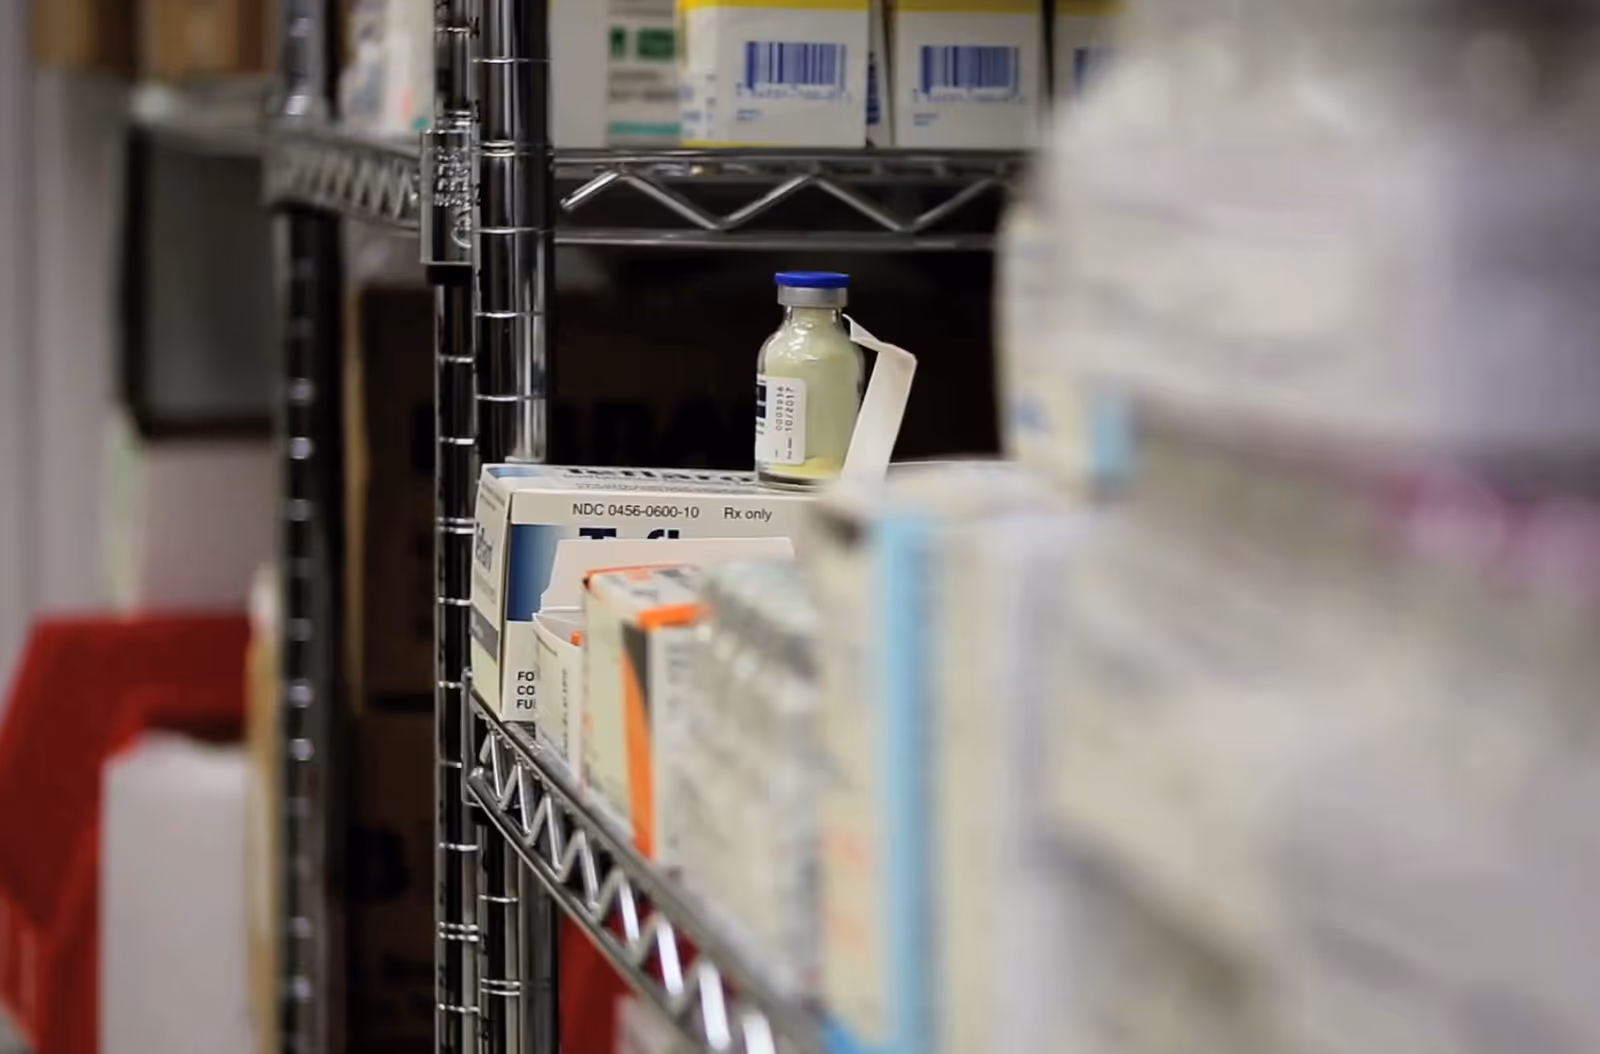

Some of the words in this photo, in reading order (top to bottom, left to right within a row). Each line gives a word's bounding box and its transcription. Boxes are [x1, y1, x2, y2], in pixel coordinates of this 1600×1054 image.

[784, 386, 795, 432] 10/2017
[572, 503, 605, 516] NDC
[608, 504, 700, 518] 0456-0600-10
[724, 507, 742, 519] Rx
[745, 507, 773, 522] only
[516, 698, 537, 710] FU
